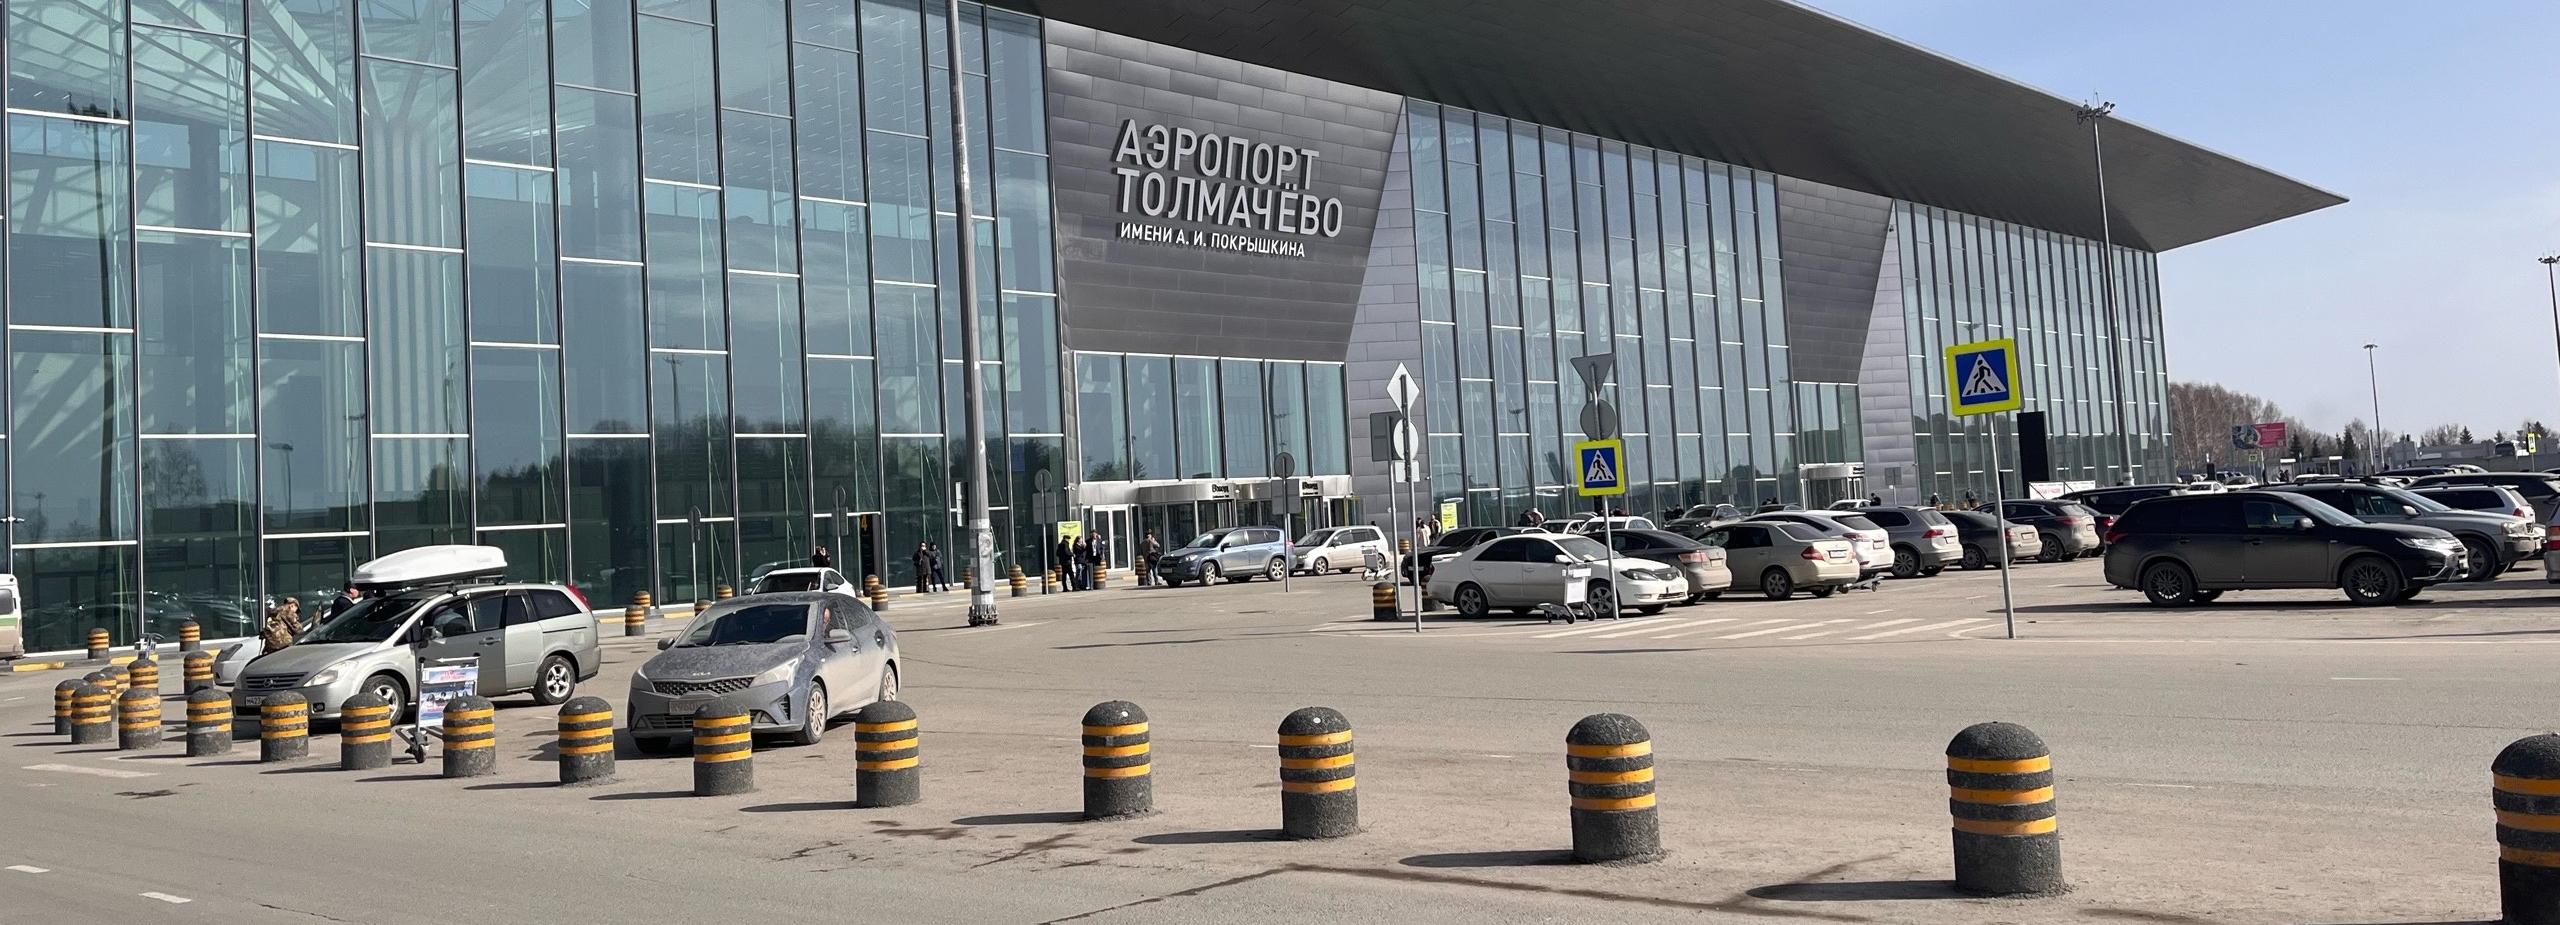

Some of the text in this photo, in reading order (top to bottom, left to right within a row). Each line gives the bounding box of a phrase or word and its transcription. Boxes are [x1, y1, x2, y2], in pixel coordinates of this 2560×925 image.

[1115, 118, 1320, 191] АЭРОПОРТ
[1115, 166, 1344, 238] ТОЛМАЧЁВО
[1120, 222, 1306, 258] ИМЕНИ А. И. ПОКРЫШКИНА
